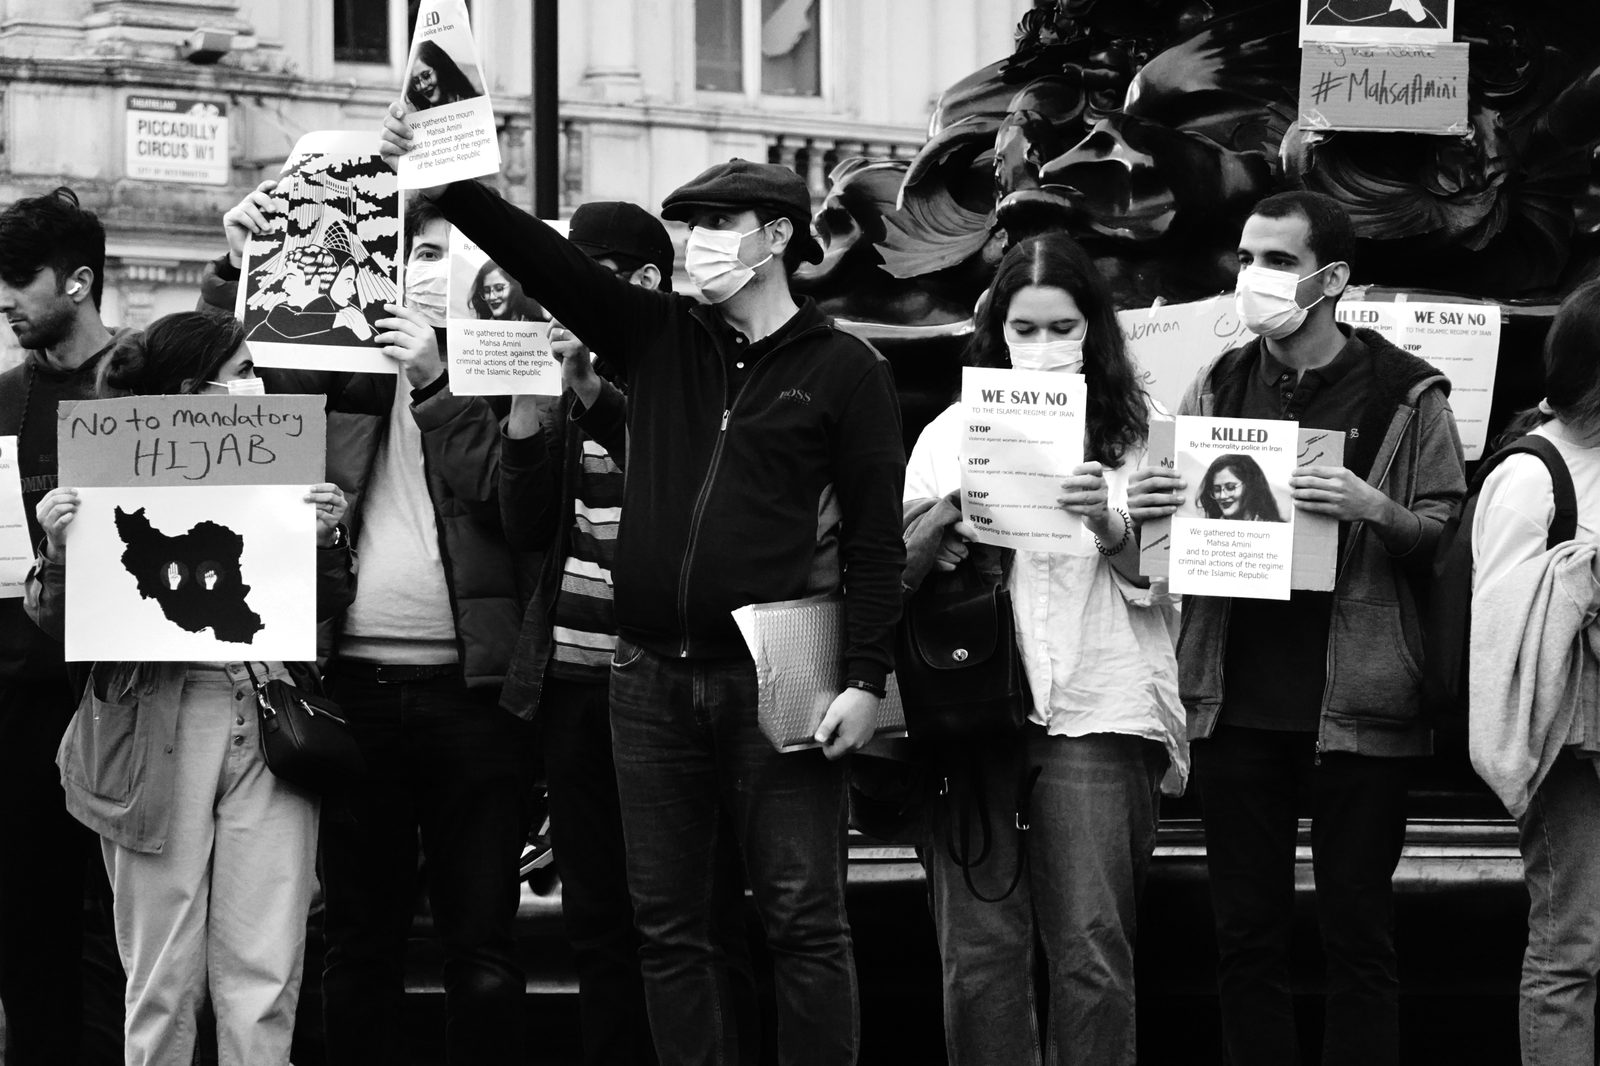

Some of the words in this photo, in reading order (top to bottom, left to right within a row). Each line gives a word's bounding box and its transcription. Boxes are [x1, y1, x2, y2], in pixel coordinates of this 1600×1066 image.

[422, 117, 447, 129] gathered
[456, 110, 474, 119] mourn
[139, 120, 218, 140] PICCADILLY
[427, 128, 445, 136] Mahsa
[447, 123, 462, 132] Amini
[432, 136, 452, 146] protest
[454, 131, 474, 141] against
[138, 140, 189, 159] CIRCUS
[195, 144, 215, 160] W1
[409, 151, 429, 161] criminal
[431, 147, 451, 156] actions
[471, 138, 490, 147] regime
[435, 158, 454, 166] Islamic
[457, 151, 480, 161] Republic
[1338, 310, 1379, 323] ILLED
[1415, 311, 1434, 323] WE
[1440, 312, 1464, 325] SAY
[1468, 313, 1486, 325] NO
[476, 330, 504, 338] gathered
[510, 350, 534, 358] against
[982, 389, 1005, 403] WE
[1011, 391, 1040, 404] SAY
[1045, 392, 1067, 406] NO
[126, 408, 160, 432] to
[970, 425, 990, 433] STOP
[1212, 427, 1268, 442] KILLED
[1213, 442, 1240, 450] morality
[135, 434, 276, 480] HIJAB
[21, 475, 57, 493] OMMY
[970, 515, 992, 525] STOP
[974, 523, 999, 535] Supporting
[1204, 529, 1235, 537] gathered
[1207, 539, 1229, 547] Mahsa
[1232, 540, 1251, 548] Amini
[1178, 558, 1206, 566] criminal
[1259, 562, 1283, 571] regime
[1239, 571, 1268, 580] Republic
